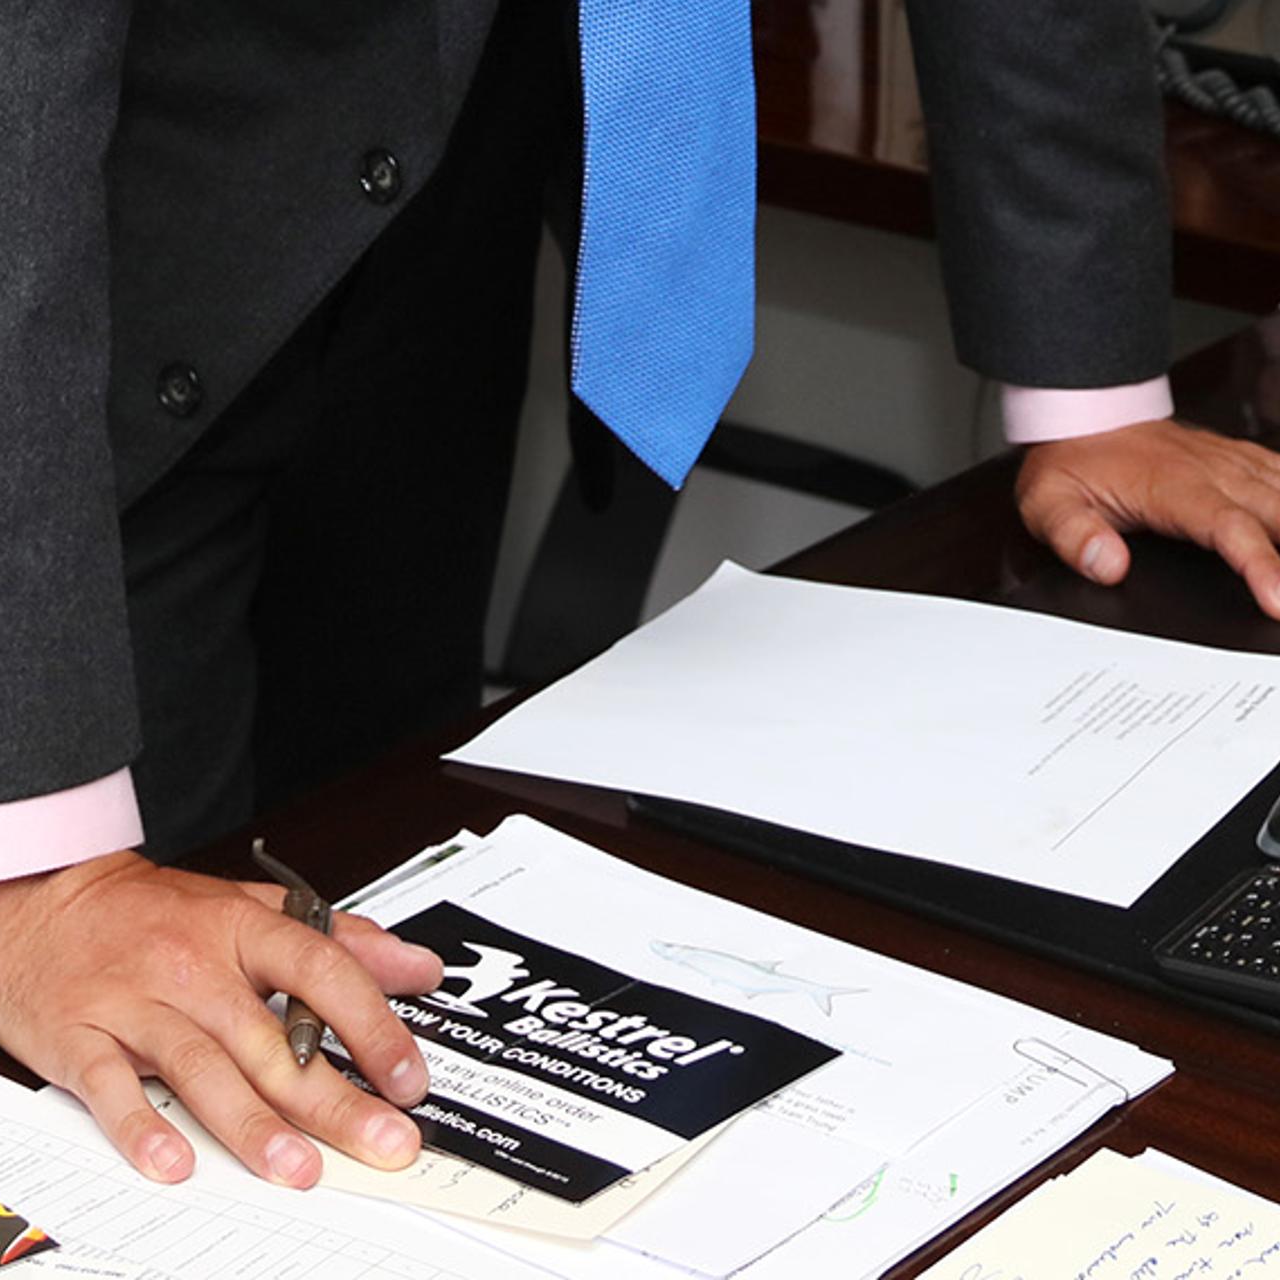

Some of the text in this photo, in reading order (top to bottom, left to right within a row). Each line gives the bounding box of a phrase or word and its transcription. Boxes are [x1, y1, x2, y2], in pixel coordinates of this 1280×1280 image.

[387, 998, 647, 1105] NOW YOUR CONDITIONS
[503, 1016, 671, 1082] Ballistics
[505, 978, 732, 1067] Kestrel
[444, 1056, 481, 1081] any
[483, 1066, 545, 1101] online
[545, 1090, 605, 1124] order
[411, 1102, 522, 1151] llistics.com
